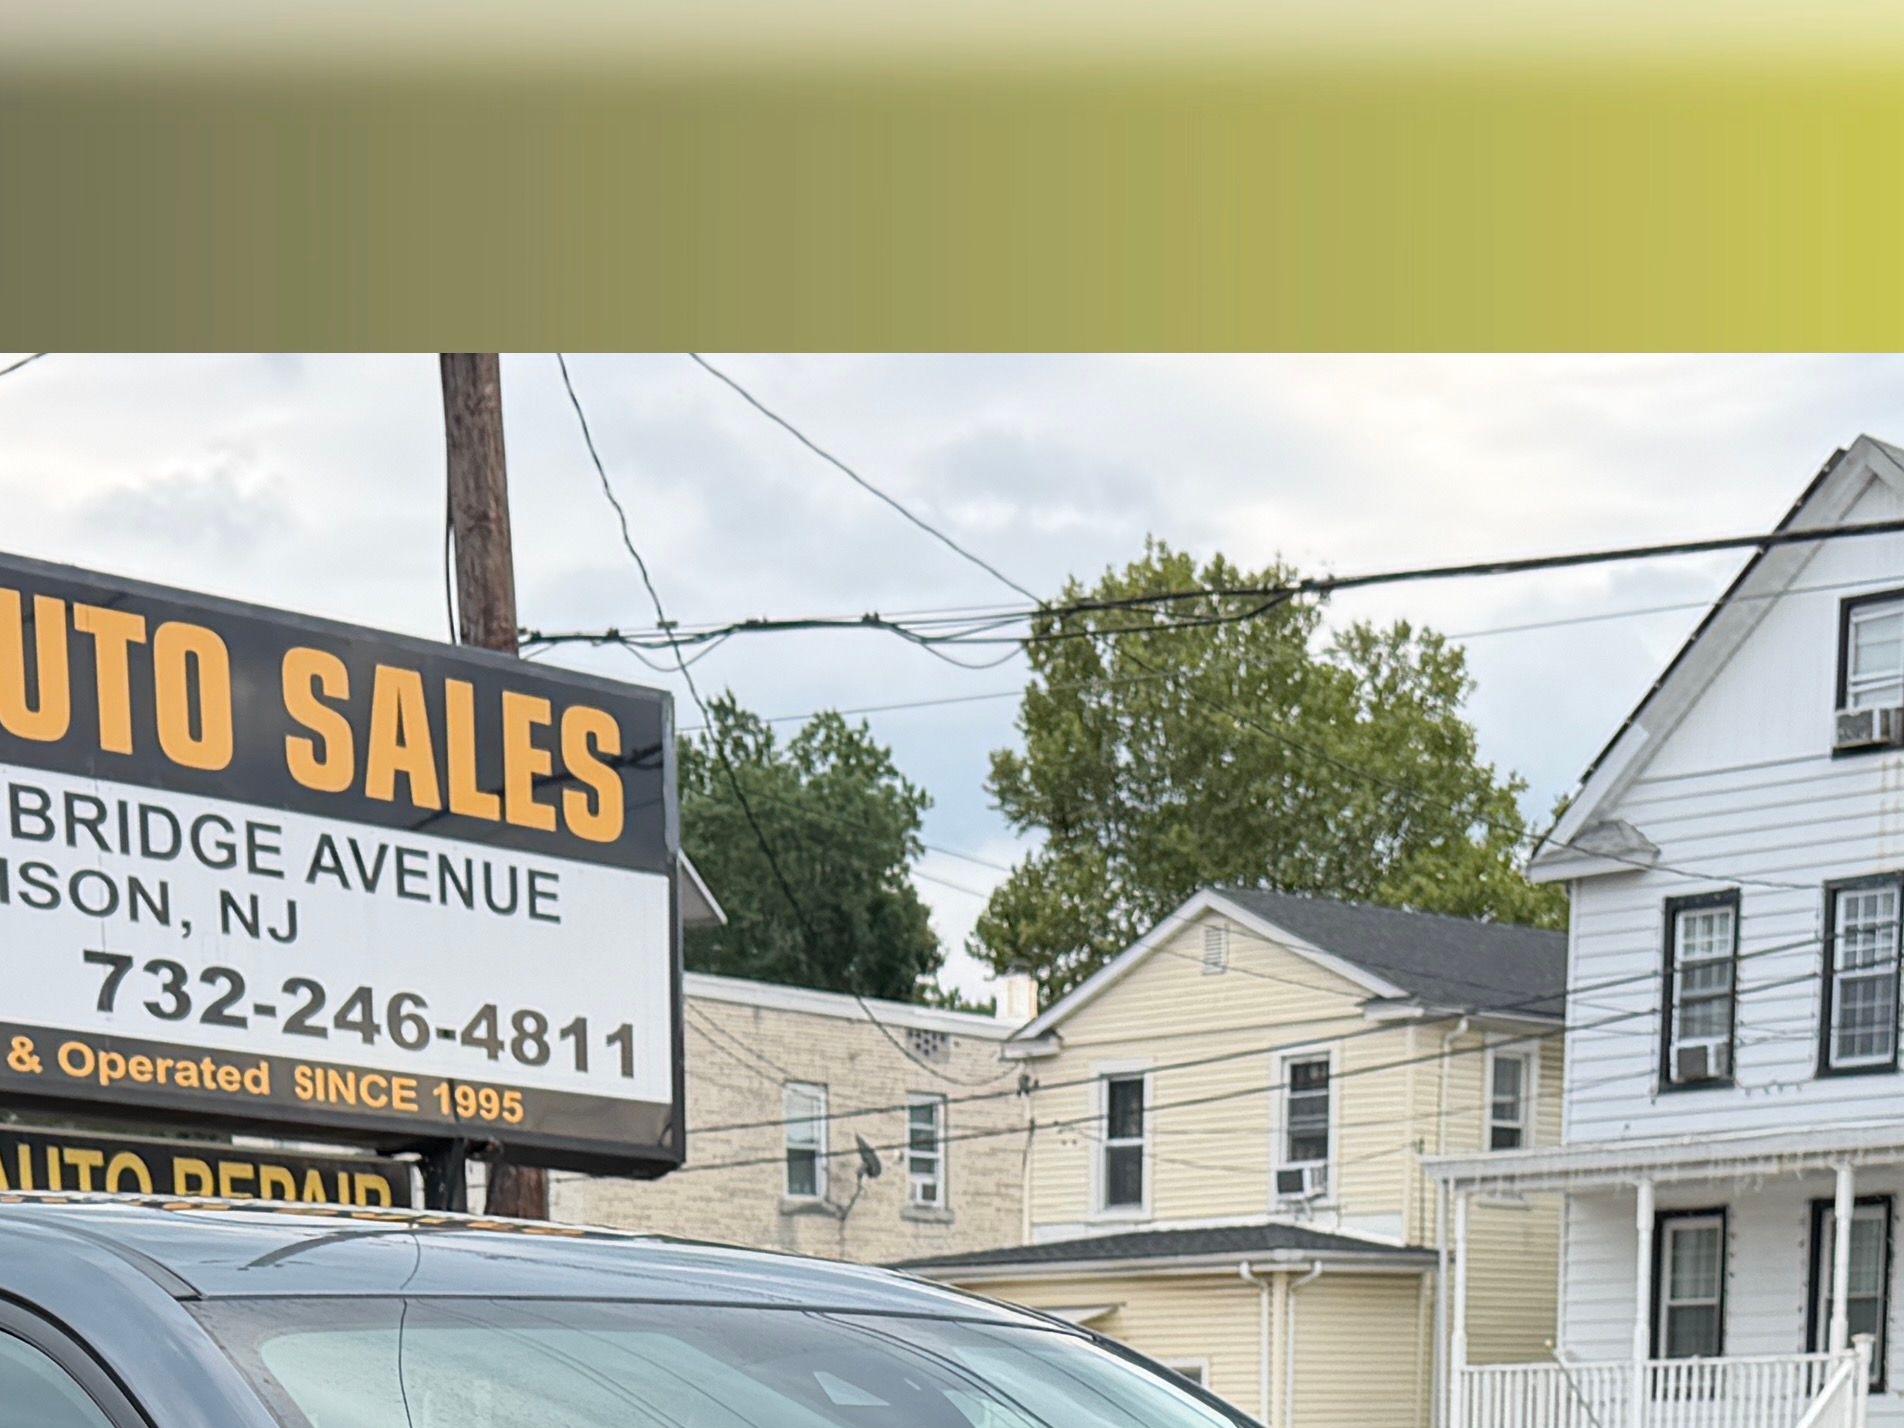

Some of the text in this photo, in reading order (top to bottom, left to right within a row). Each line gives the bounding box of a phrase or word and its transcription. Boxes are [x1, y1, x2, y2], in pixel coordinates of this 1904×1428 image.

[281, 646, 626, 845] SALES
[219, 893, 300, 945] NJ
[306, 833, 563, 925] AVENUE
[82, 949, 635, 1080] 732-246-4811
[7, 1036, 43, 1074] &
[58, 1041, 271, 1097] Operated
[294, 1065, 419, 1114] SINCE
[433, 1082, 526, 1126] 1995
